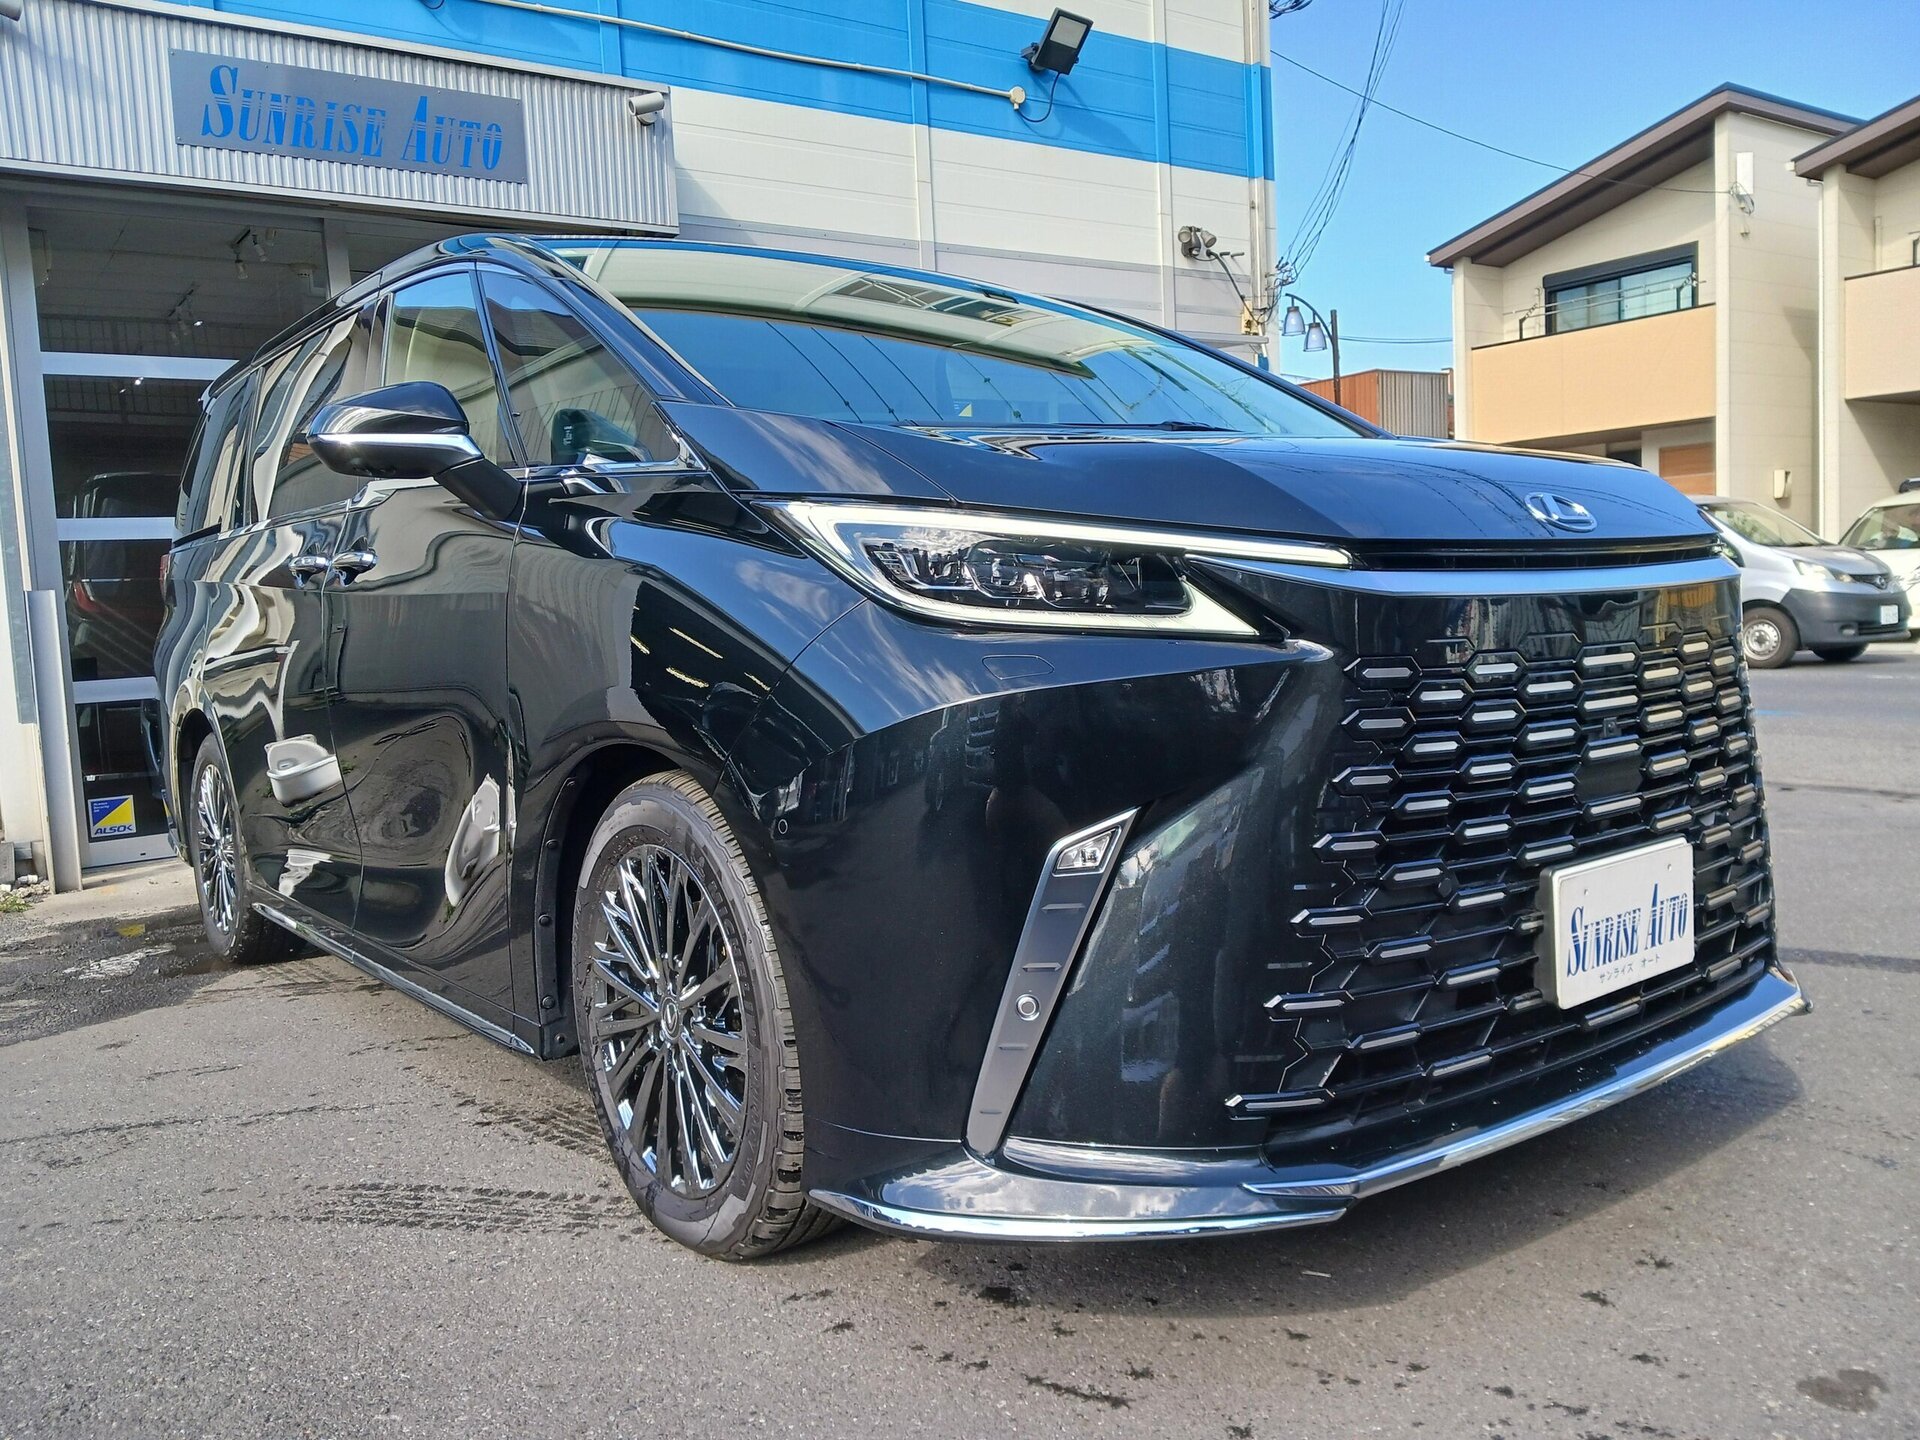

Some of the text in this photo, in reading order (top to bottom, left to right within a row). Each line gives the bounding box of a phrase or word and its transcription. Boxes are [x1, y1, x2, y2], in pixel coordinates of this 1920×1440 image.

[202, 65, 504, 171] SUNRISE AUTO
[95, 825, 133, 835] ALSOK
[1567, 883, 1688, 977] SUNRISE AUTO
